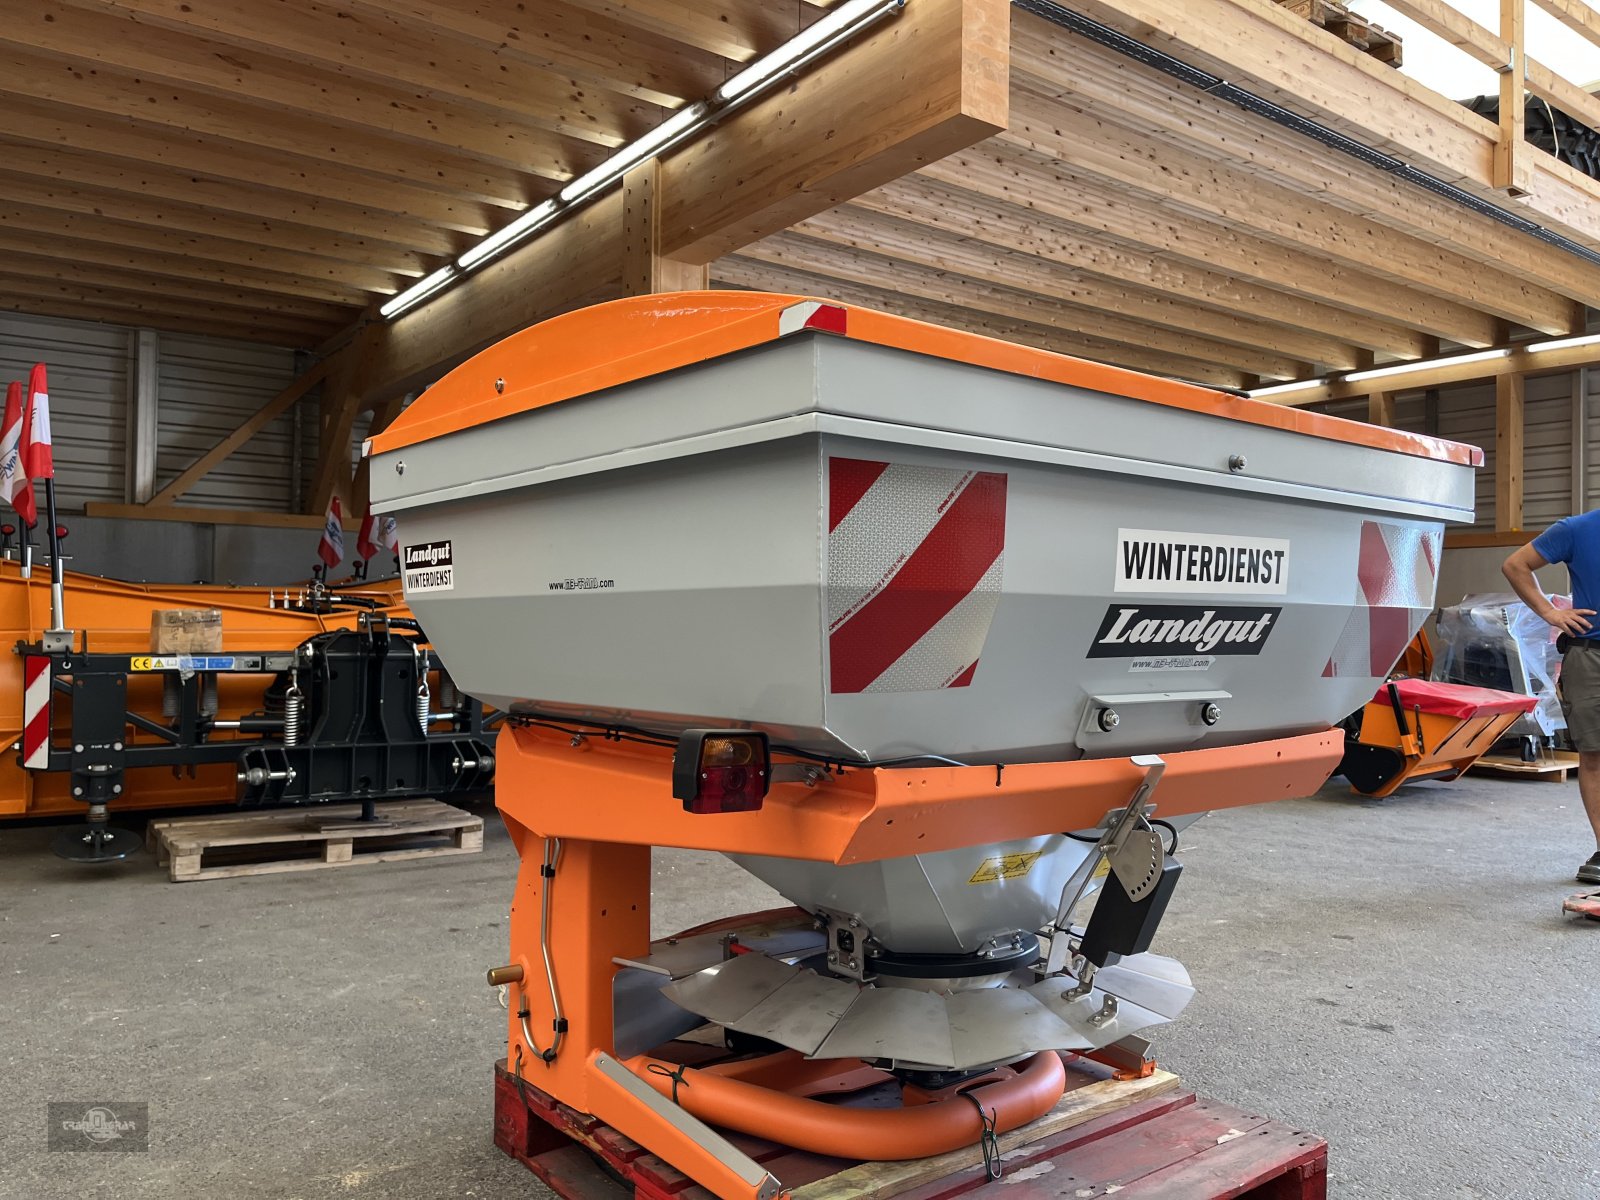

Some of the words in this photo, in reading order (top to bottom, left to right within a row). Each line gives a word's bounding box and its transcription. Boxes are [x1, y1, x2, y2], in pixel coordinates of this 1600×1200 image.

[406, 543, 450, 565] Landgut
[1123, 541, 1284, 584] WINTERDIENST
[407, 570, 451, 588] WINTERDIENST
[1099, 609, 1272, 652] Landgut
